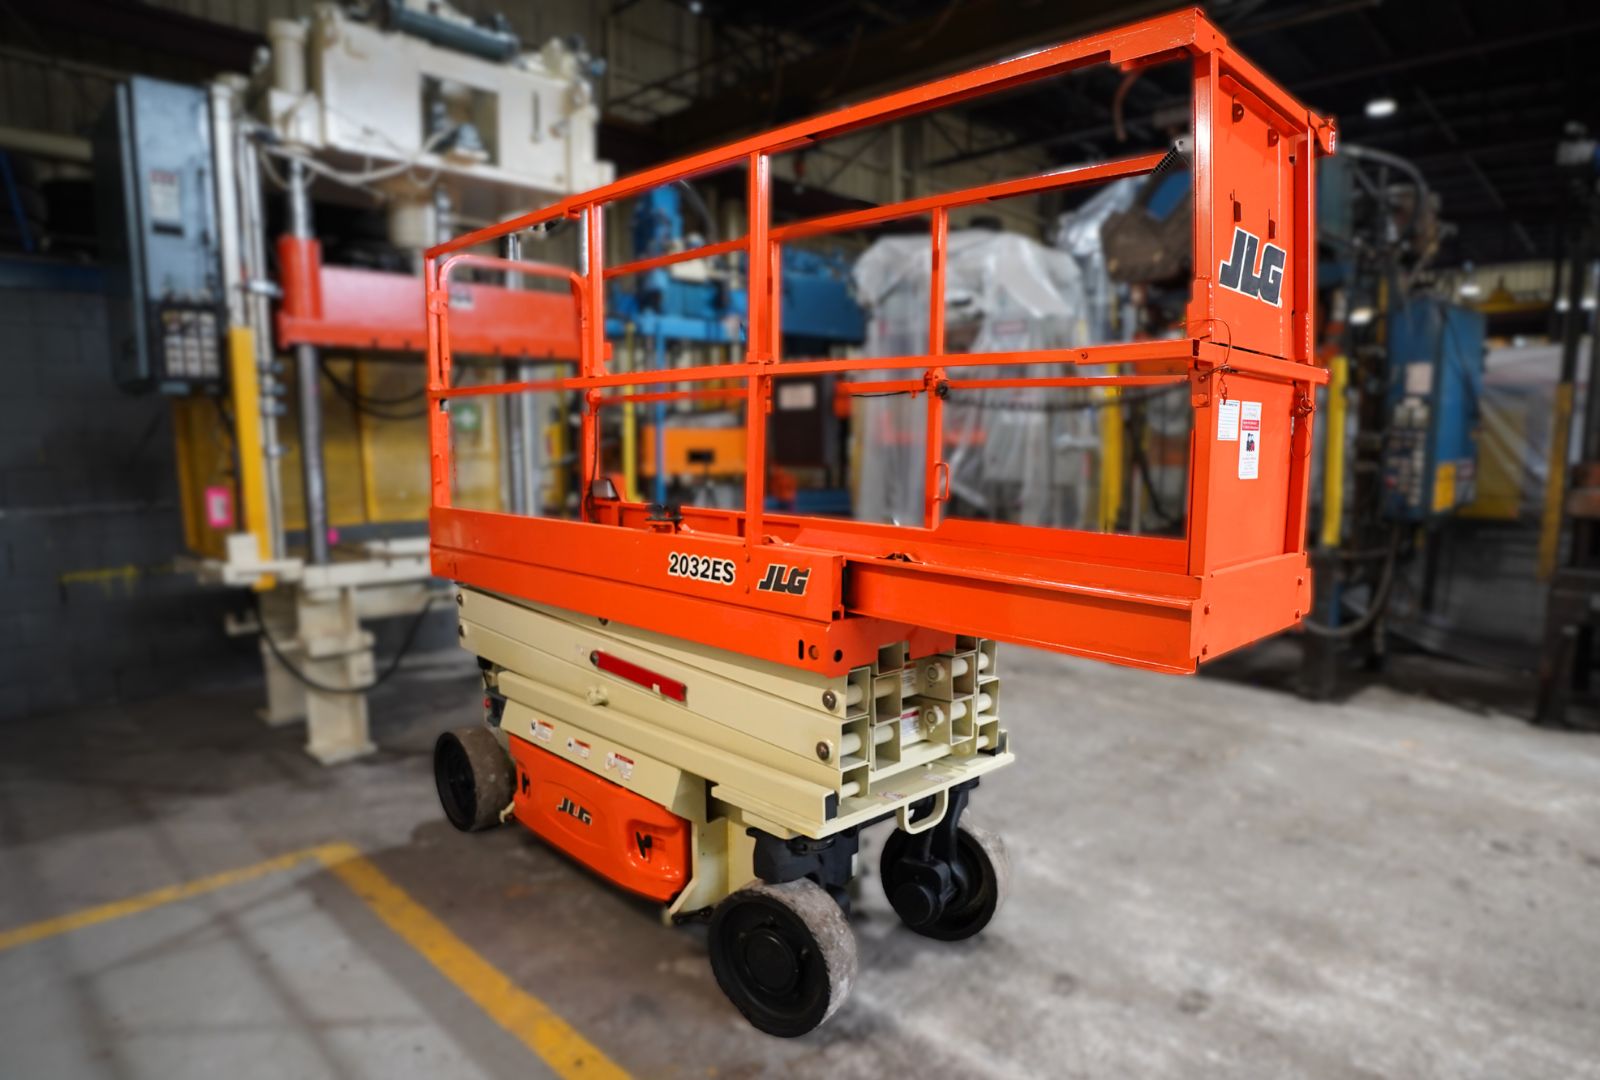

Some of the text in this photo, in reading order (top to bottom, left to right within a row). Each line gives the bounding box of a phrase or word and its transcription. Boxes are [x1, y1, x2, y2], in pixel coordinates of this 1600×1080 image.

[1219, 227, 1286, 307] JLG
[669, 552, 735, 584] 2032ES
[758, 565, 810, 595] JLG
[557, 798, 592, 826] JLG
